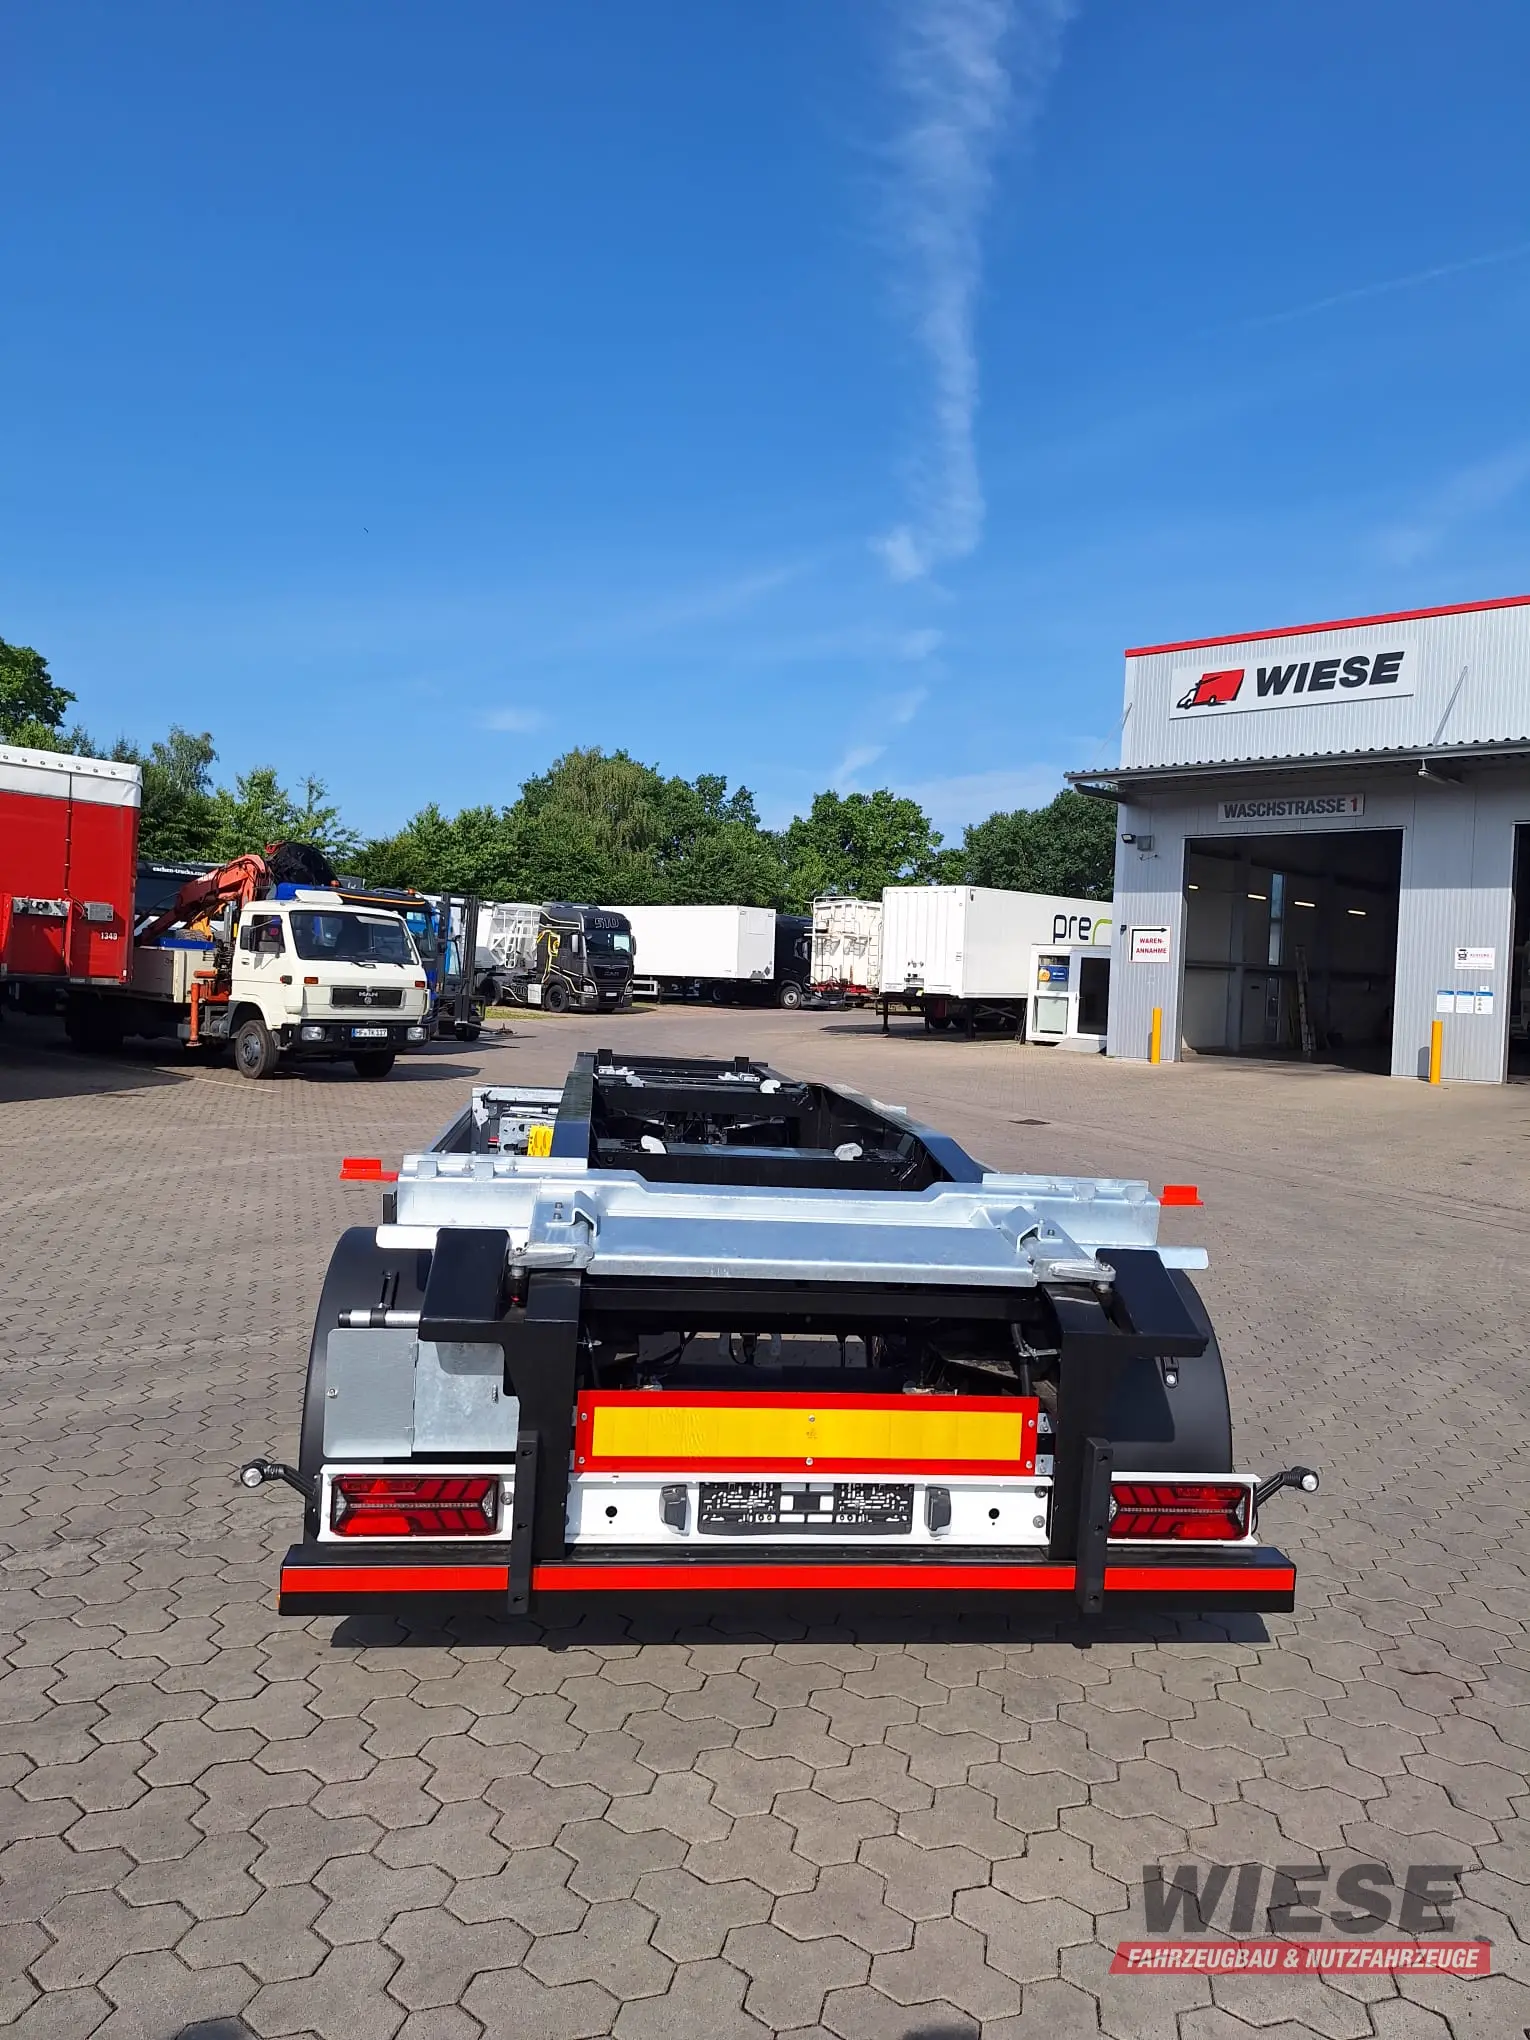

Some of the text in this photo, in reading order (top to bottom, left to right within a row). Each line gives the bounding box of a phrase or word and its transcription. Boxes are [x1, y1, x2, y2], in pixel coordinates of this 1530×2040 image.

[1256, 651, 1405, 697] WIESE
[1224, 797, 1358, 819] WASCHSTRASSE 1
[594, 917, 620, 929] 510
